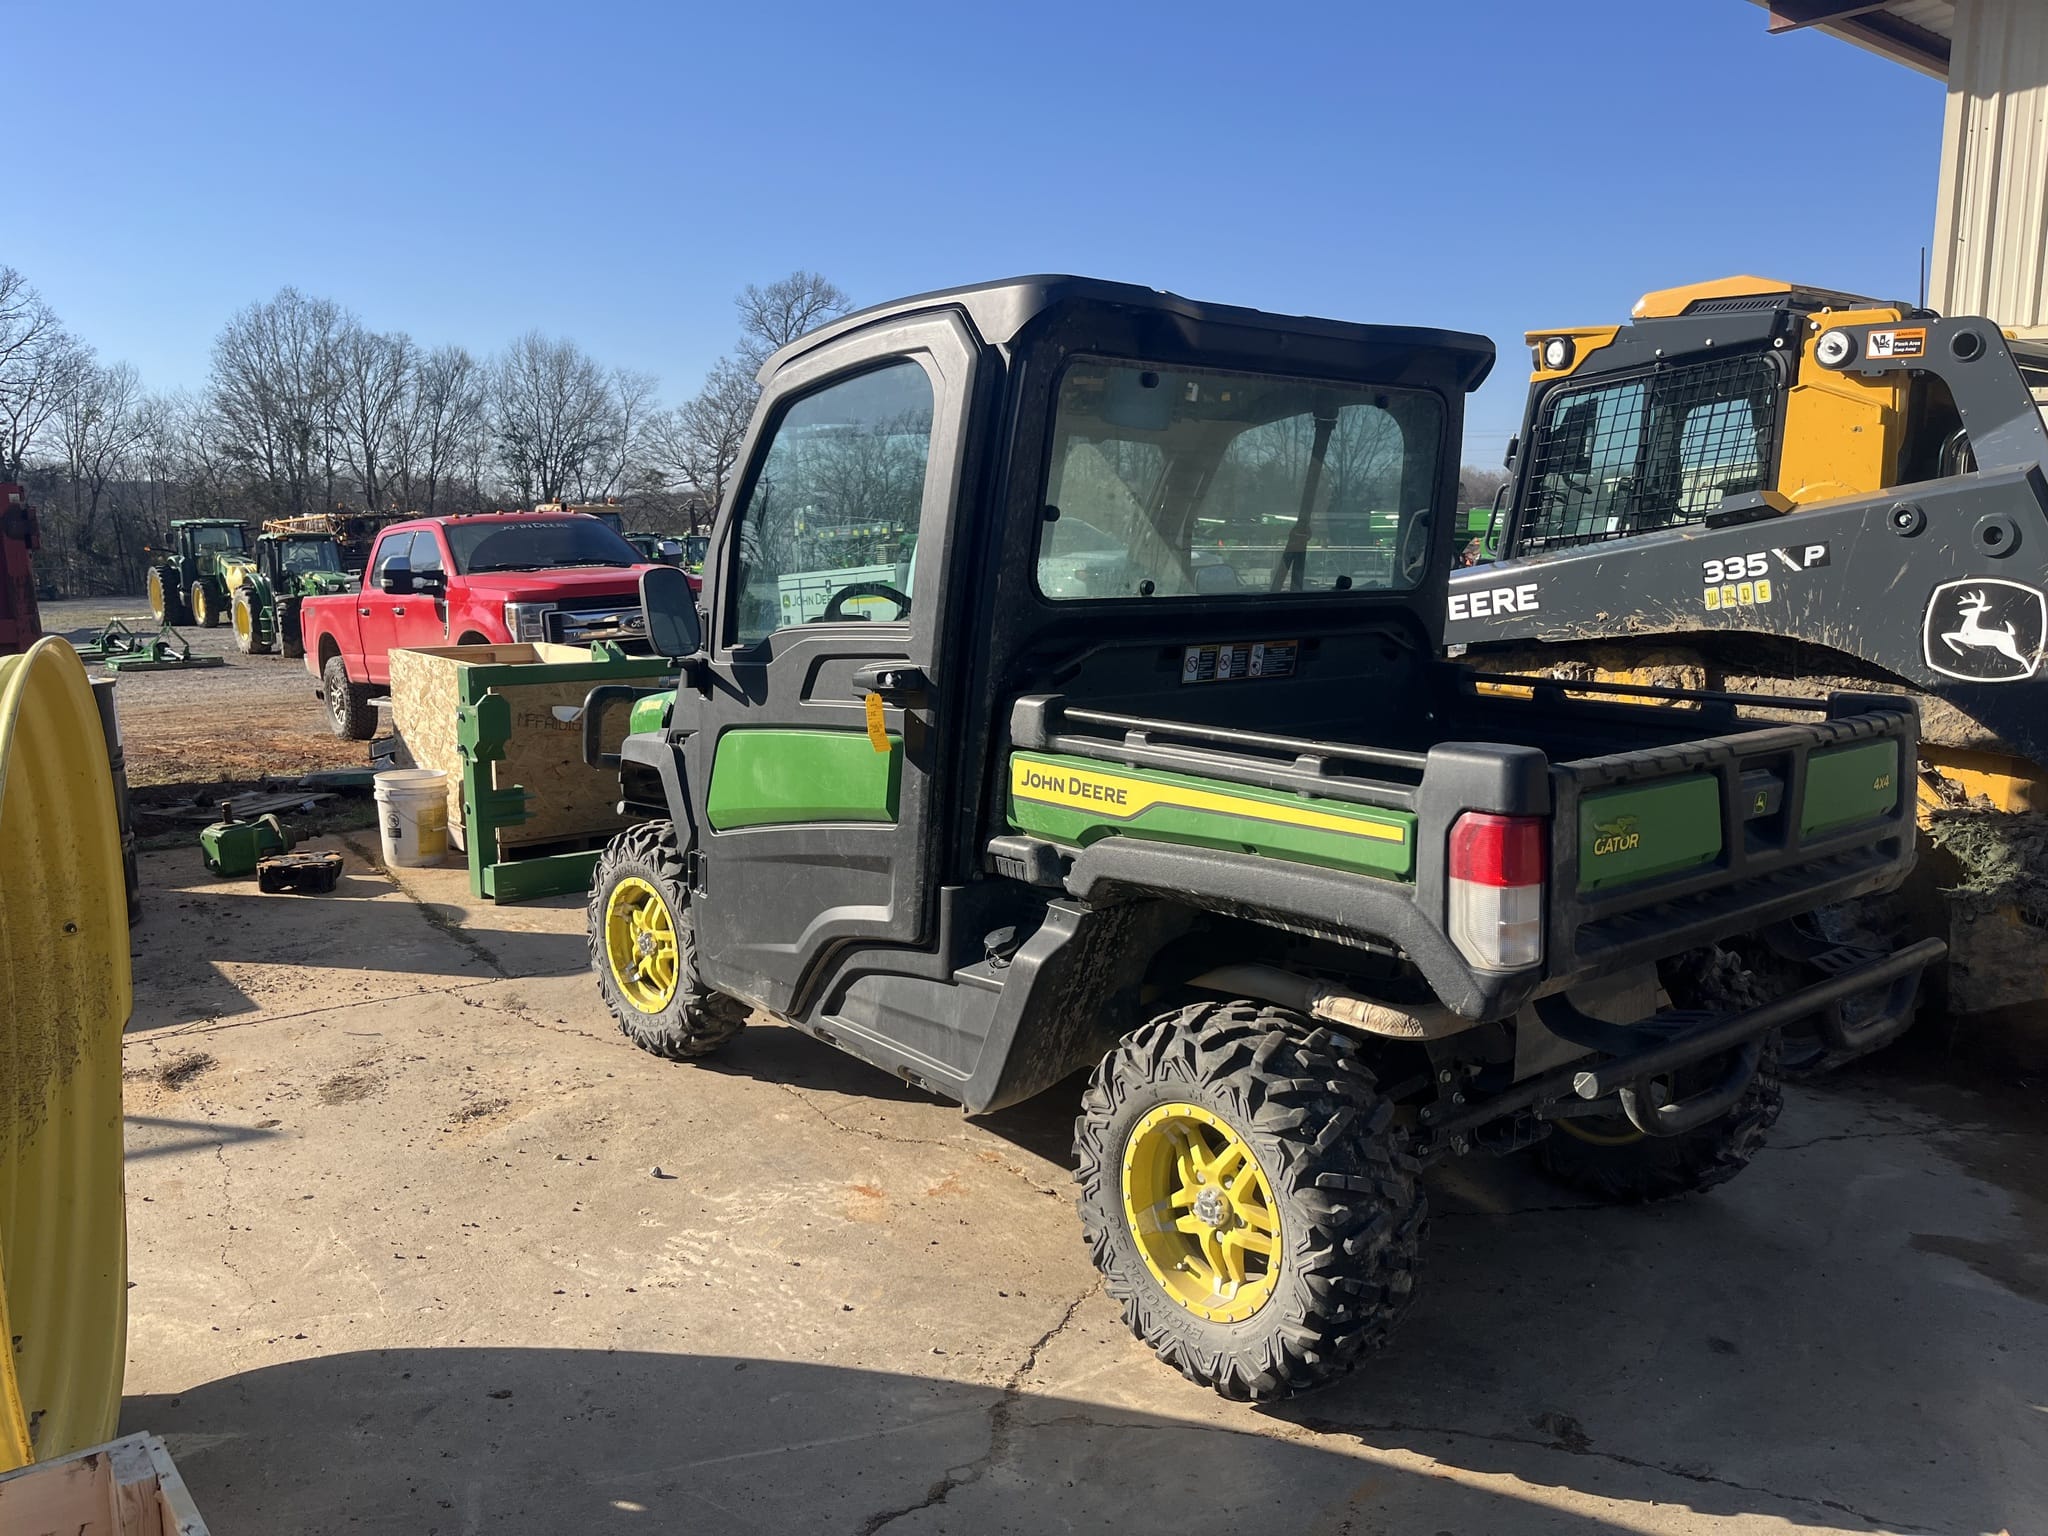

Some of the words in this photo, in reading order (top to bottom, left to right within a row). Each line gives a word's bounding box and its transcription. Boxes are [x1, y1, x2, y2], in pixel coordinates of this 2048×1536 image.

[1703, 552, 1769, 583] 335
[792, 595, 814, 606] JOHN
[815, 593, 832, 605] DEE
[1447, 583, 1539, 621] EERE
[1021, 769, 1065, 793] JOHN
[1068, 776, 1128, 805] DEERE
[1594, 832, 1640, 856] GATOR
